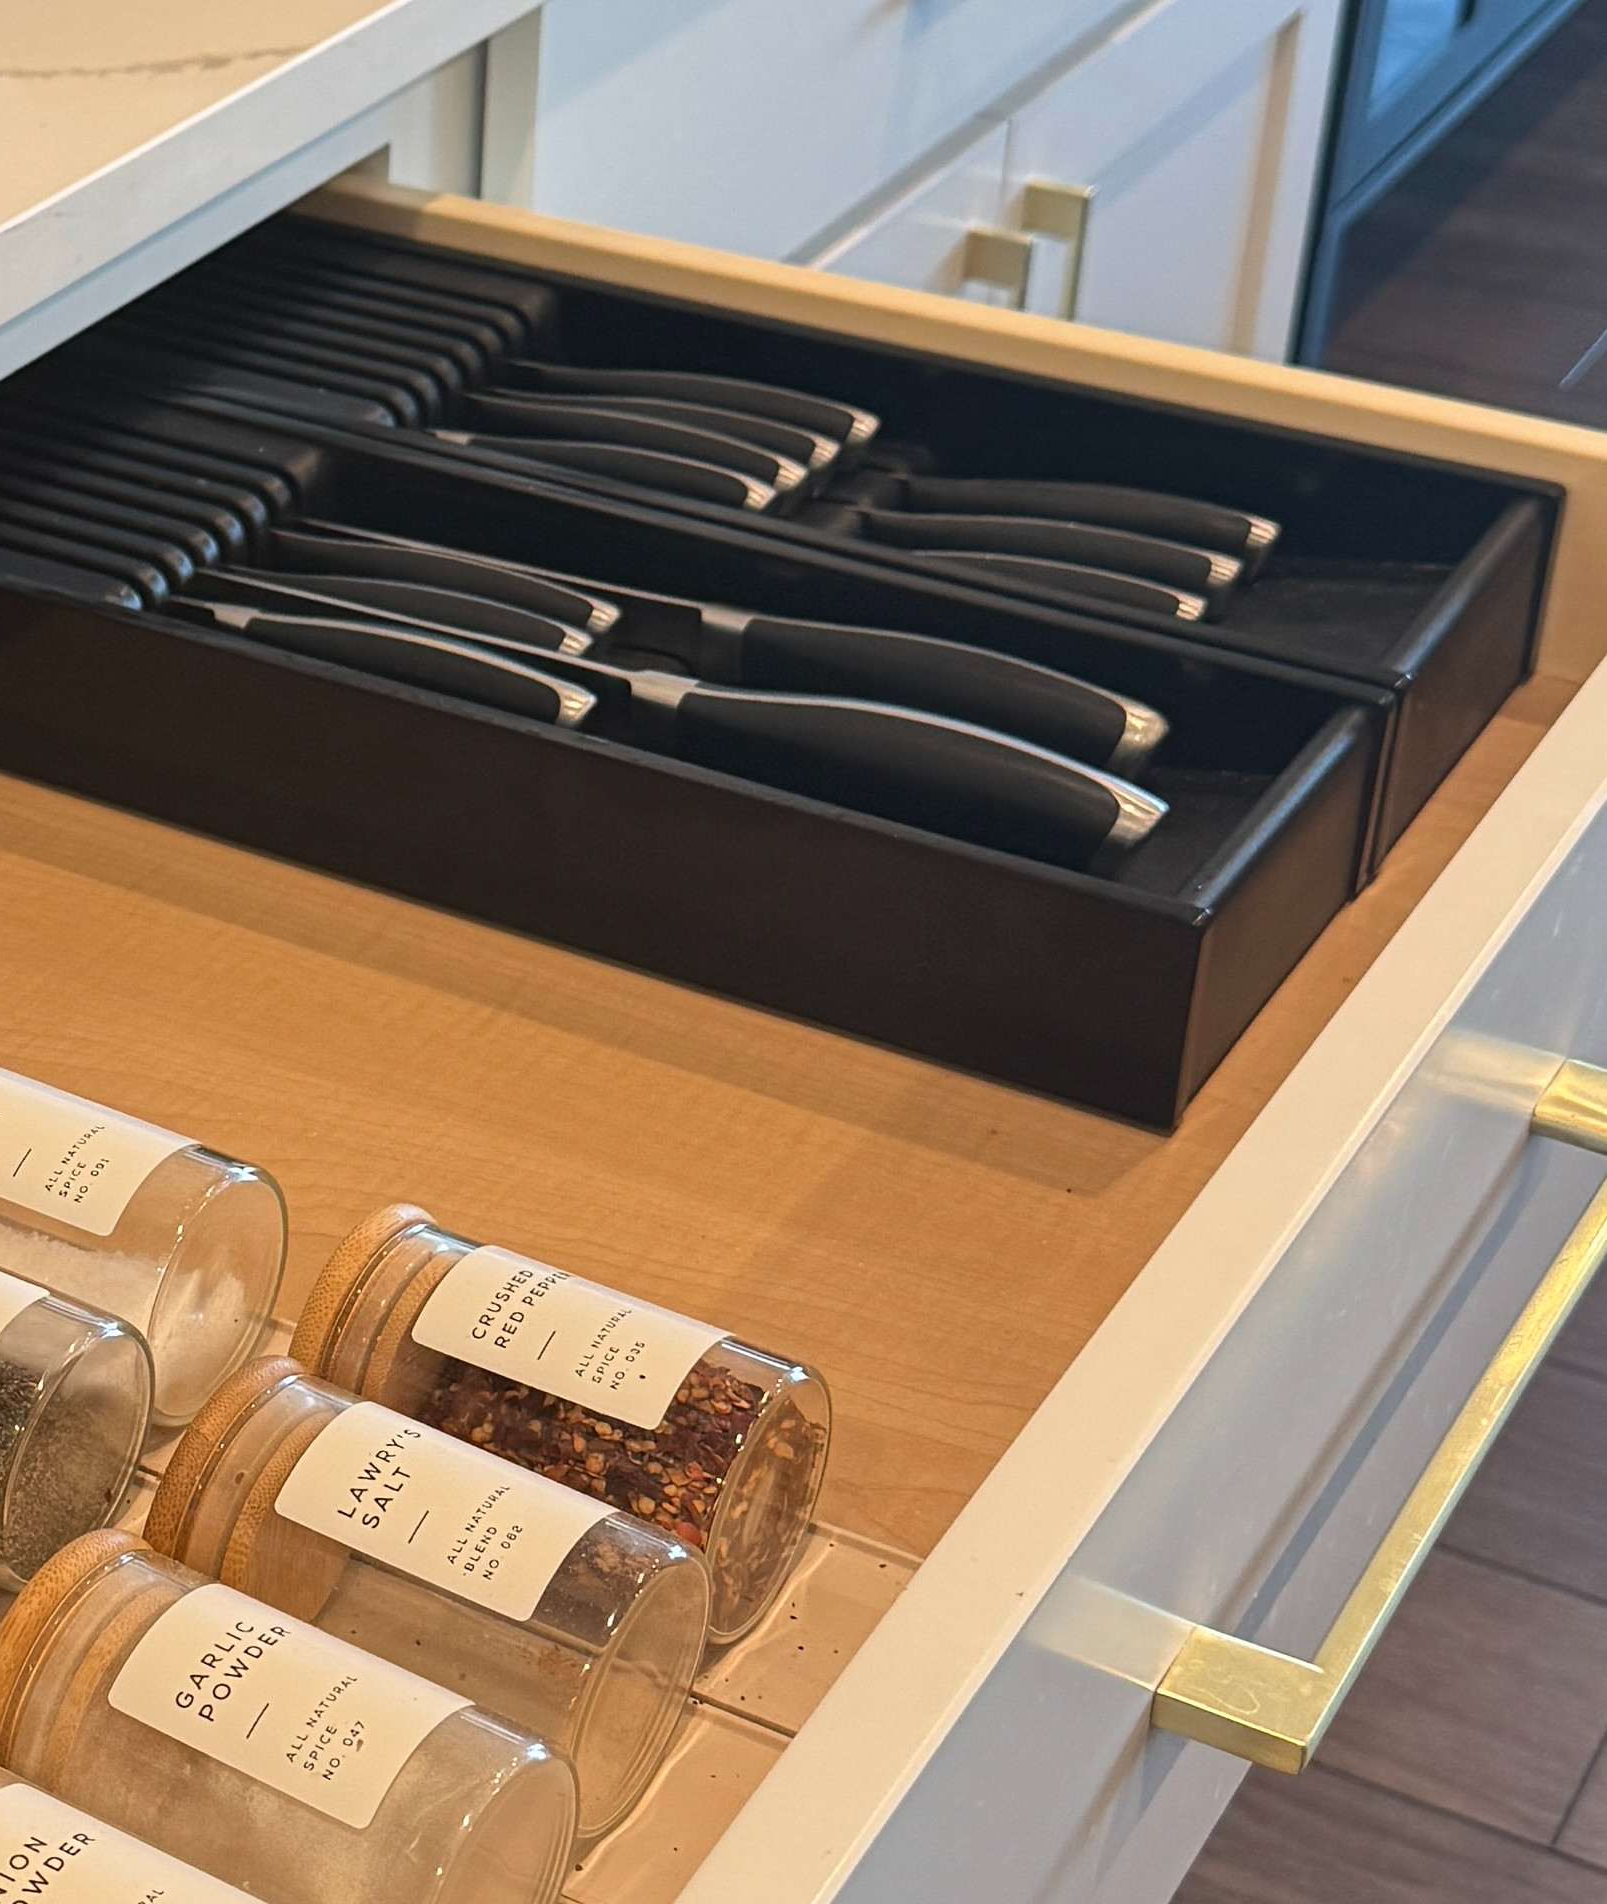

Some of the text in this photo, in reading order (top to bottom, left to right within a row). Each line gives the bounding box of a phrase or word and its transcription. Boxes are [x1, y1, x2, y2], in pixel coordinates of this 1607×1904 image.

[44, 1125, 106, 1192] ALL NATURAL
[58, 1162, 87, 1198] SPICE
[472, 1269, 534, 1340] CRUSHED
[495, 1313, 525, 1348] RED
[575, 1308, 633, 1378] ALL NATURAL
[592, 1346, 620, 1384] SPICE
[337, 1428, 422, 1519] LAWRY'S
[362, 1466, 411, 1529] SALT
[447, 1485, 511, 1564] ALL NATURAL
[466, 1526, 498, 1573] BLEND
[175, 1621, 255, 1710] GARLIC
[198, 1625, 291, 1722] POWDER
[286, 1675, 358, 1763] ALL NATURAL
[303, 1725, 338, 1771] SPICE
[322, 1720, 366, 1781] NO. 047
